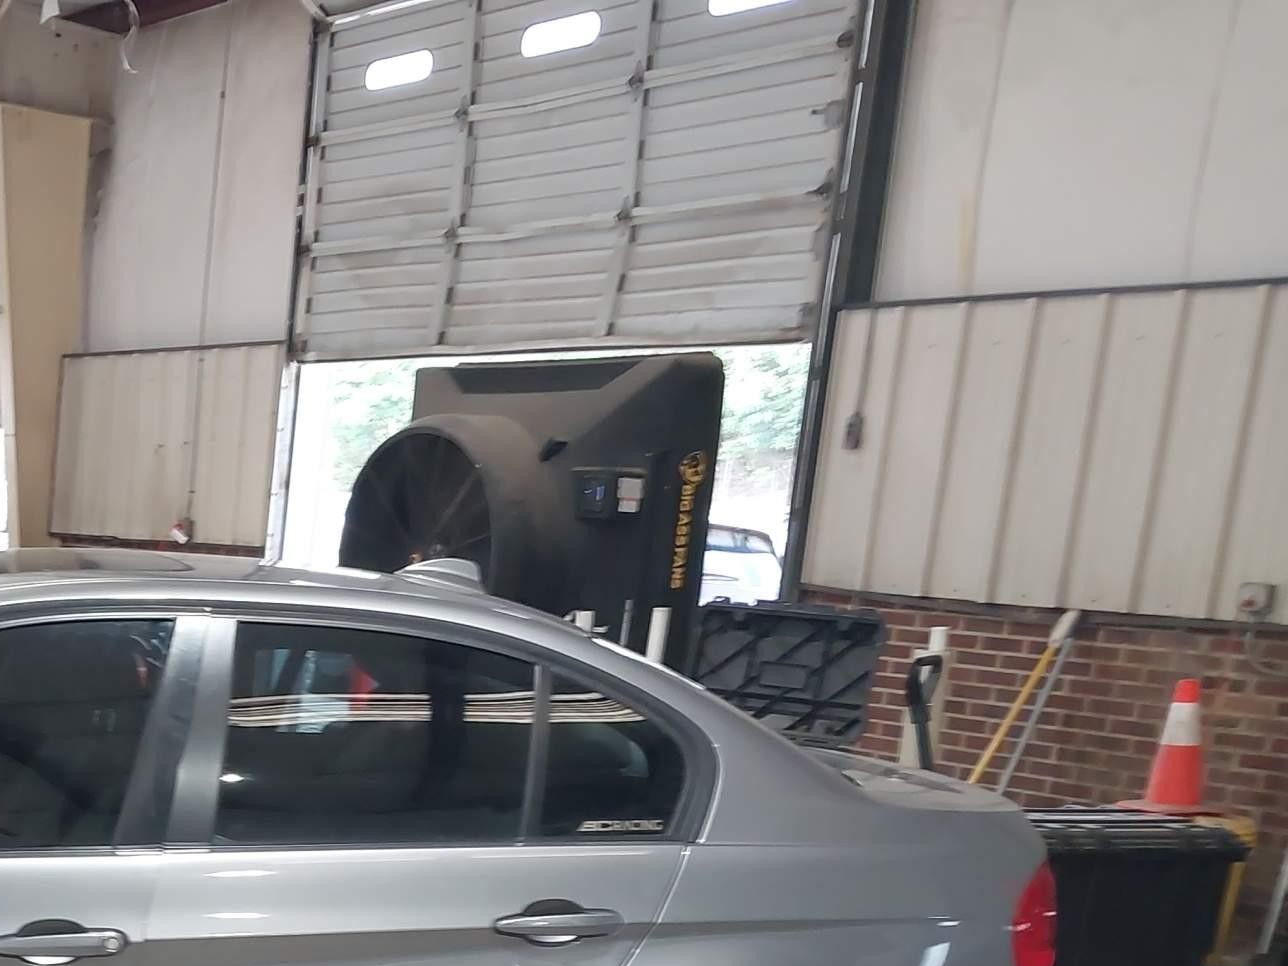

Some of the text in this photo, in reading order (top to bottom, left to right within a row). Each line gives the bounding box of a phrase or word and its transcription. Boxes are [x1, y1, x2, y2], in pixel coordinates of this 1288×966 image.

[670, 484, 696, 589] BIG ASS FANS
